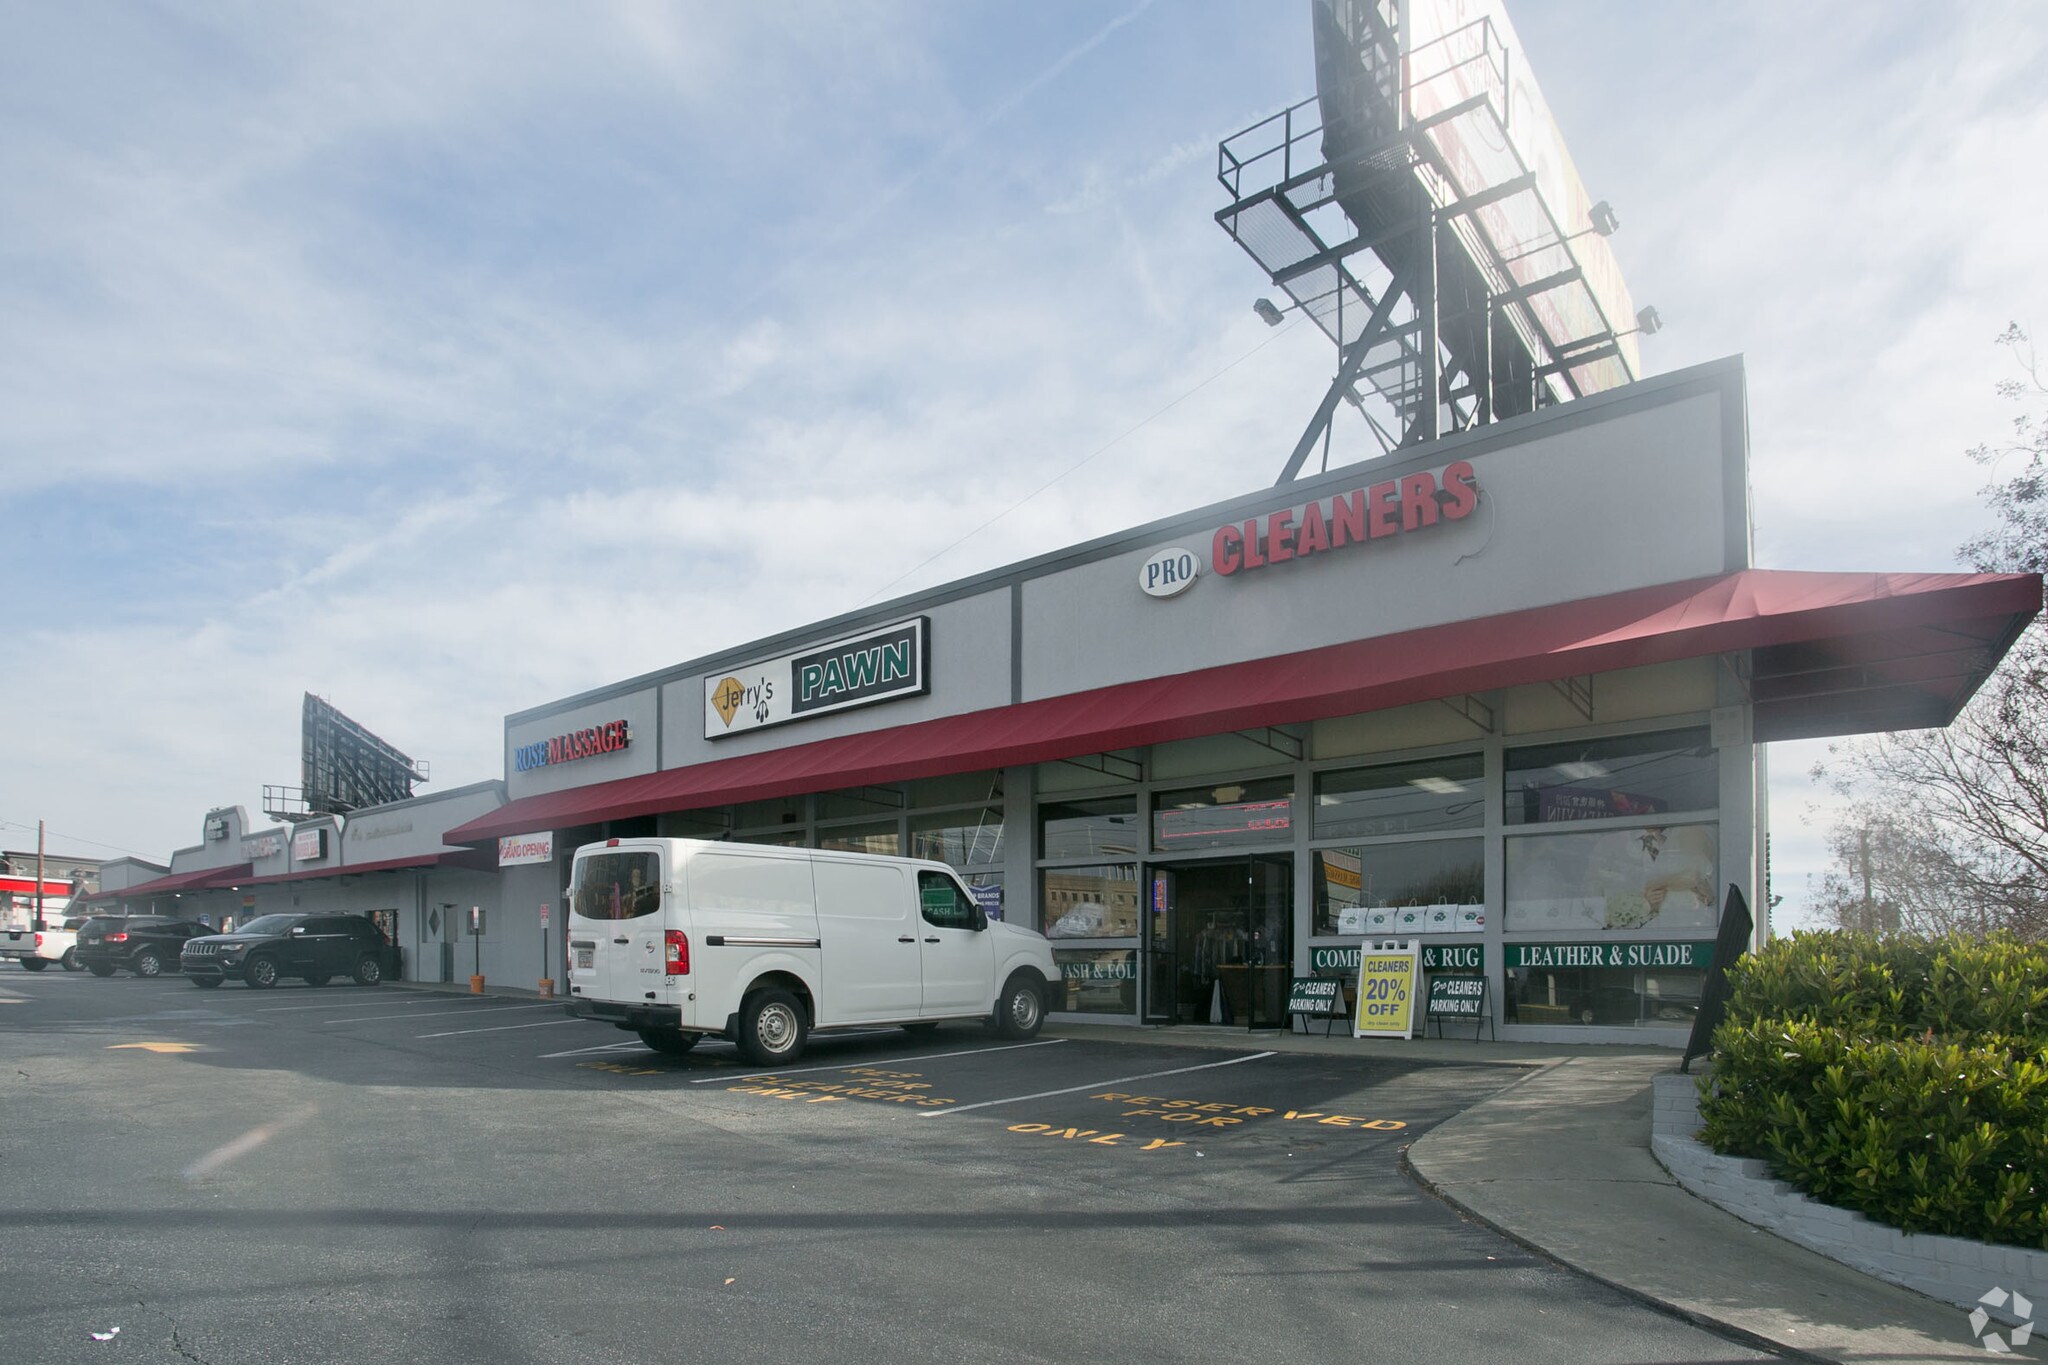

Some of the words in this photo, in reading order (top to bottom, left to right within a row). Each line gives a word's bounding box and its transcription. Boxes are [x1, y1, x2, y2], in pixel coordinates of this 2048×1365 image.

[1147, 554, 1192, 589] PRO
[1212, 461, 1477, 577] CLEANERS
[802, 639, 910, 702] PAWN
[722, 677, 774, 711] Jerry's
[514, 741, 547, 772] ROSE
[547, 719, 627, 765] MASSAGE
[522, 842, 549, 857] OPENING
[1316, 949, 1361, 967] COMF
[1424, 948, 1436, 966] &
[1442, 947, 1480, 967] RUG
[1519, 945, 1605, 966] LEATHER
[1609, 945, 1623, 966] &
[1628, 944, 1693, 966] SUADE
[1093, 963, 1104, 979] &
[1107, 963, 1137, 979] FOL
[1367, 961, 1410, 973] CLEANERS
[1305, 982, 1337, 995] CLEANERS
[1366, 978, 1406, 1002] 20%
[1447, 981, 1483, 996] CLEANERS
[1289, 998, 1315, 1012] PARKING
[1315, 999, 1333, 1012] ONLY
[1367, 1004, 1400, 1016] OFF
[1430, 999, 1460, 1012] PARKING
[1460, 1000, 1480, 1013] ONLY
[741, 1075, 956, 1106] CLEANERS
[843, 1078, 933, 1090] FOR
[726, 1085, 848, 1103] ONLY
[1088, 1092, 1408, 1131] RESERVED
[1122, 1108, 1243, 1127] FOR
[1006, 1123, 1187, 1151] ONLY
